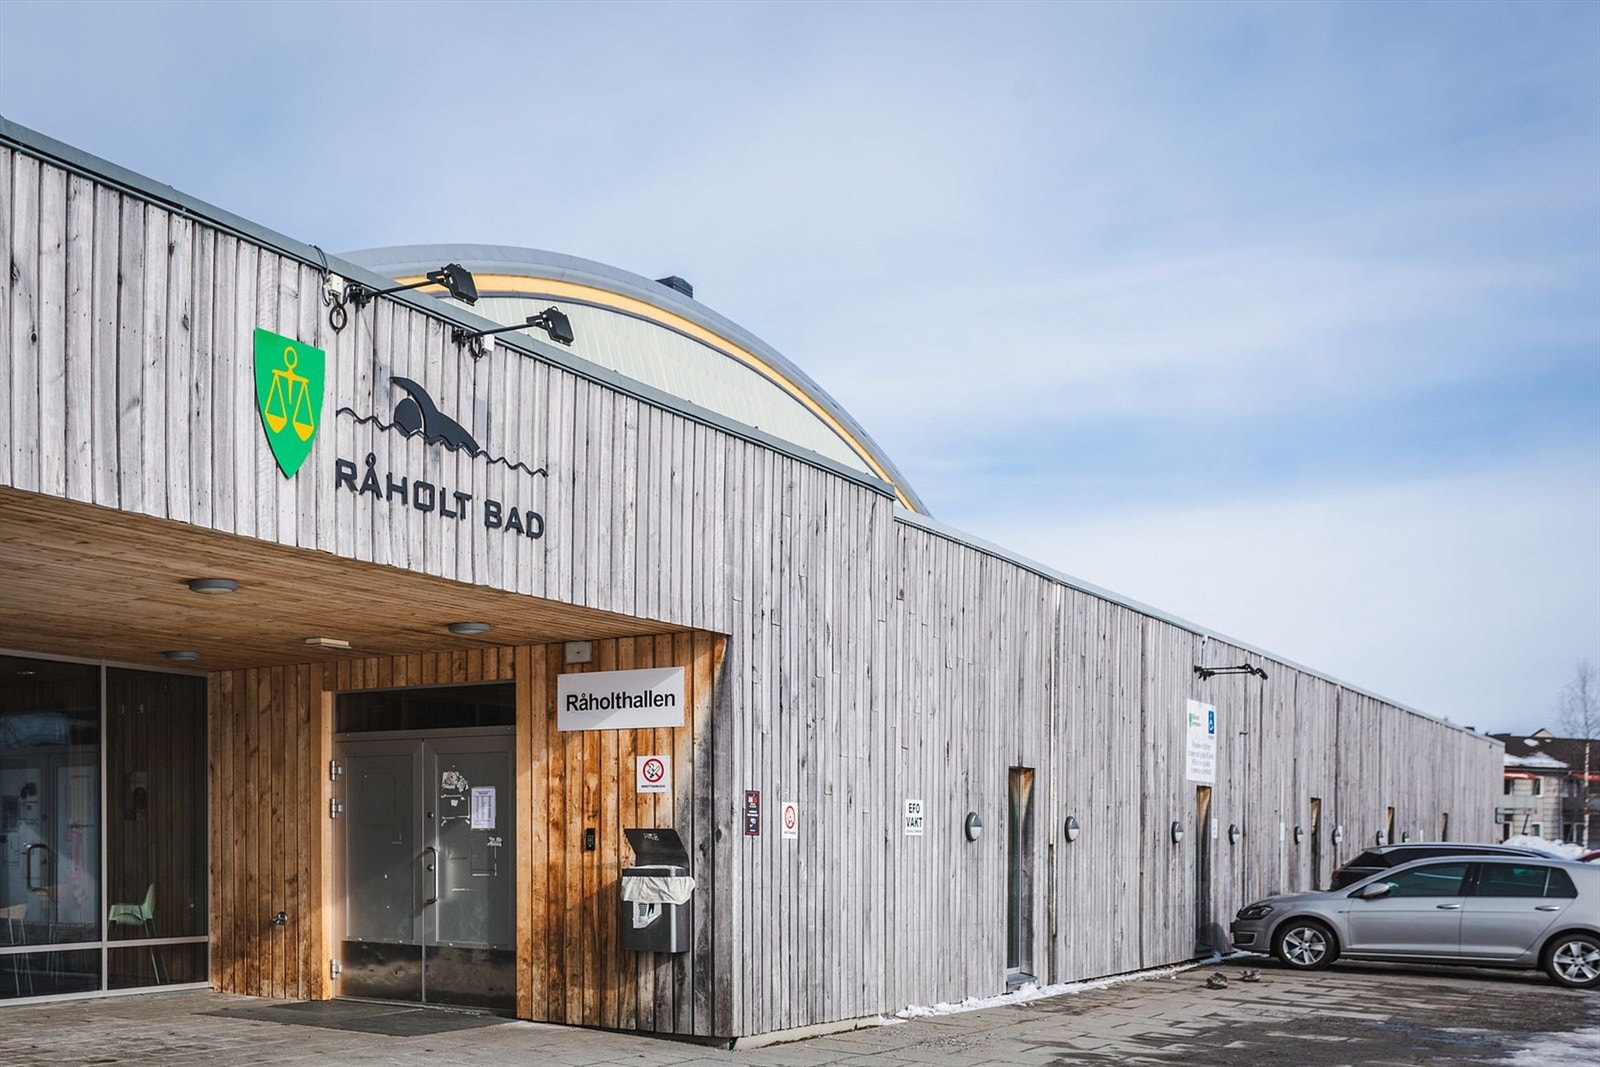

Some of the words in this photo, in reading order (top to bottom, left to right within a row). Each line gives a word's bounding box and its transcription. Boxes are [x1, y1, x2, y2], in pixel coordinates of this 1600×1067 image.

[335, 452, 472, 520] RÅHOLT
[484, 499, 544, 539] BAD
[566, 690, 676, 711] Råholthallen
[908, 803, 920, 813] EFO
[906, 817, 922, 827] VAKT
